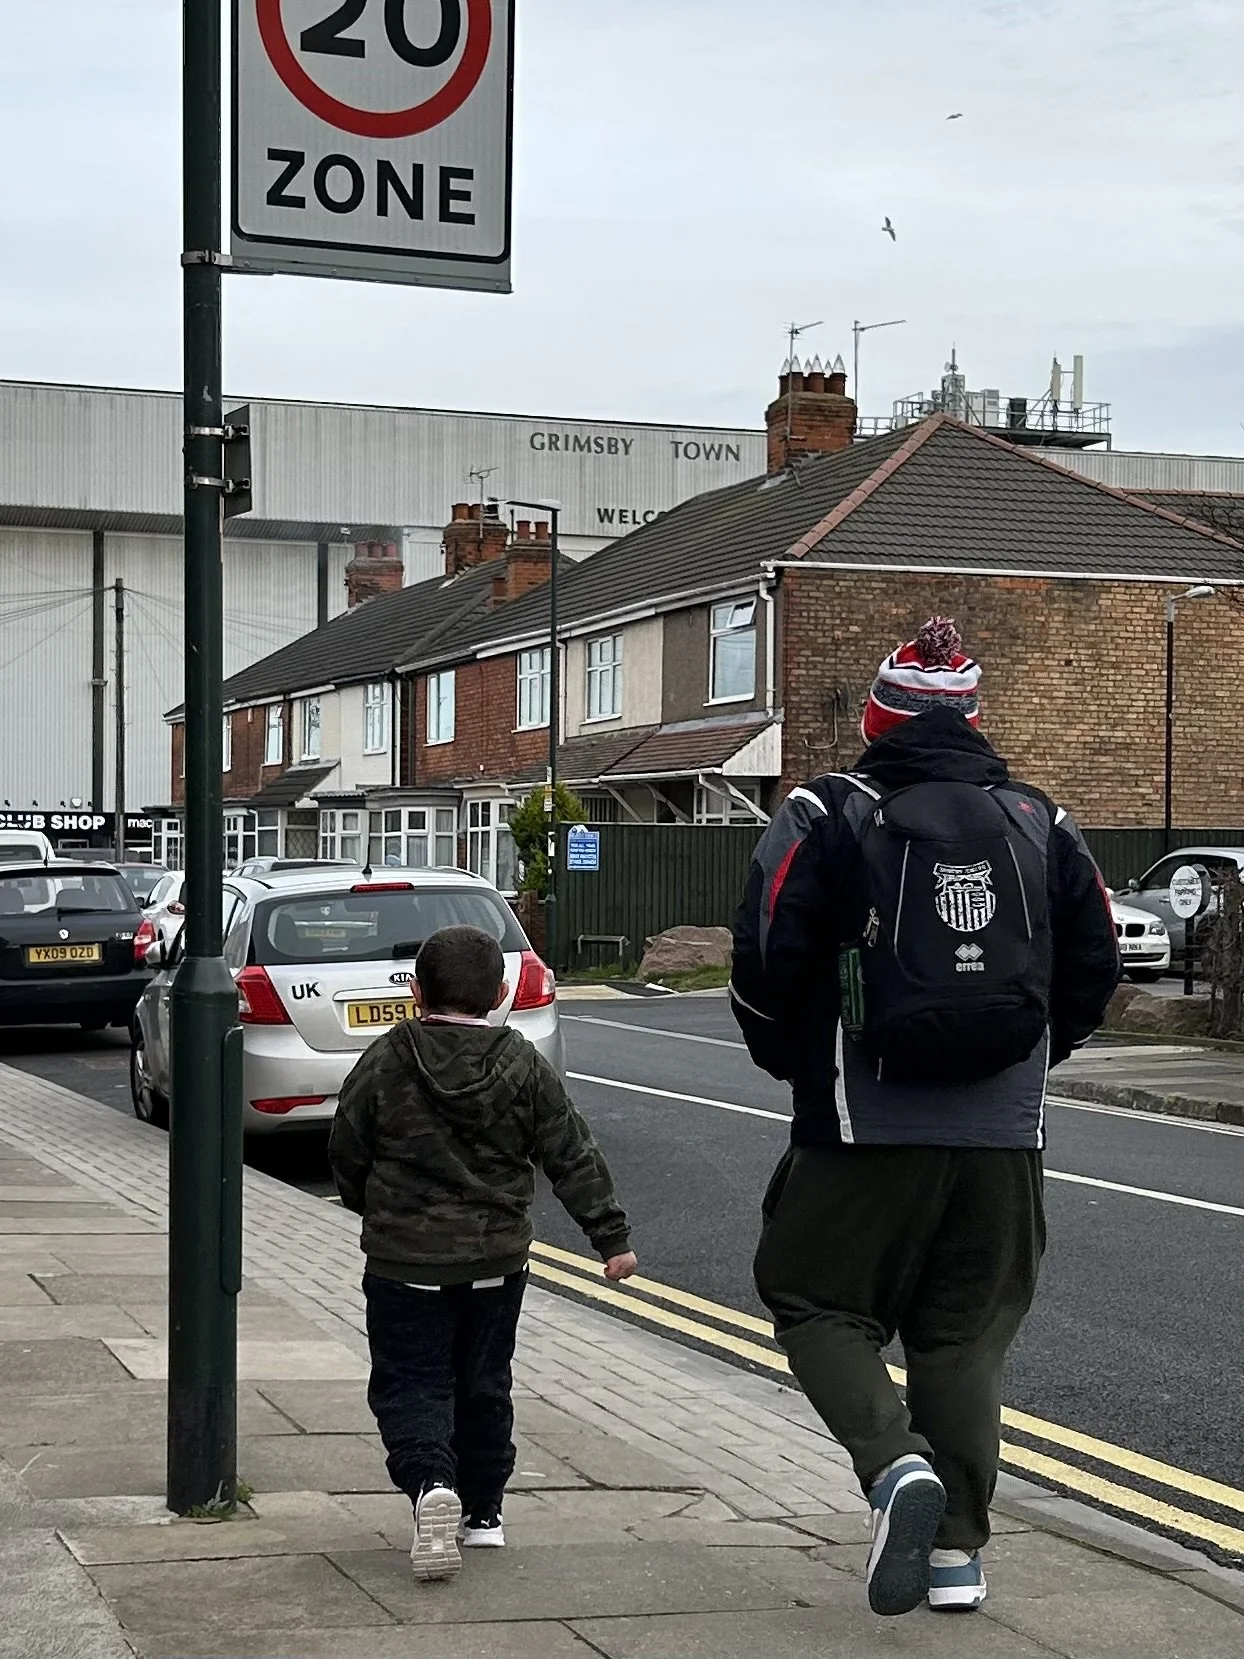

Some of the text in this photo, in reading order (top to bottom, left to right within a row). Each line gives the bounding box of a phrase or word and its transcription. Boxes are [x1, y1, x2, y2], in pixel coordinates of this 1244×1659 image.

[300, 0, 461, 67] 20
[266, 148, 476, 226] ZONE
[529, 431, 740, 461] GRIMSBY TOWN
[597, 507, 668, 525] WELC
[51, 815, 106, 830] SHOP
[35, 947, 67, 960] YX09
[393, 973, 413, 982] KIA
[292, 982, 321, 1000] UK
[355, 1003, 407, 1023] LD59
